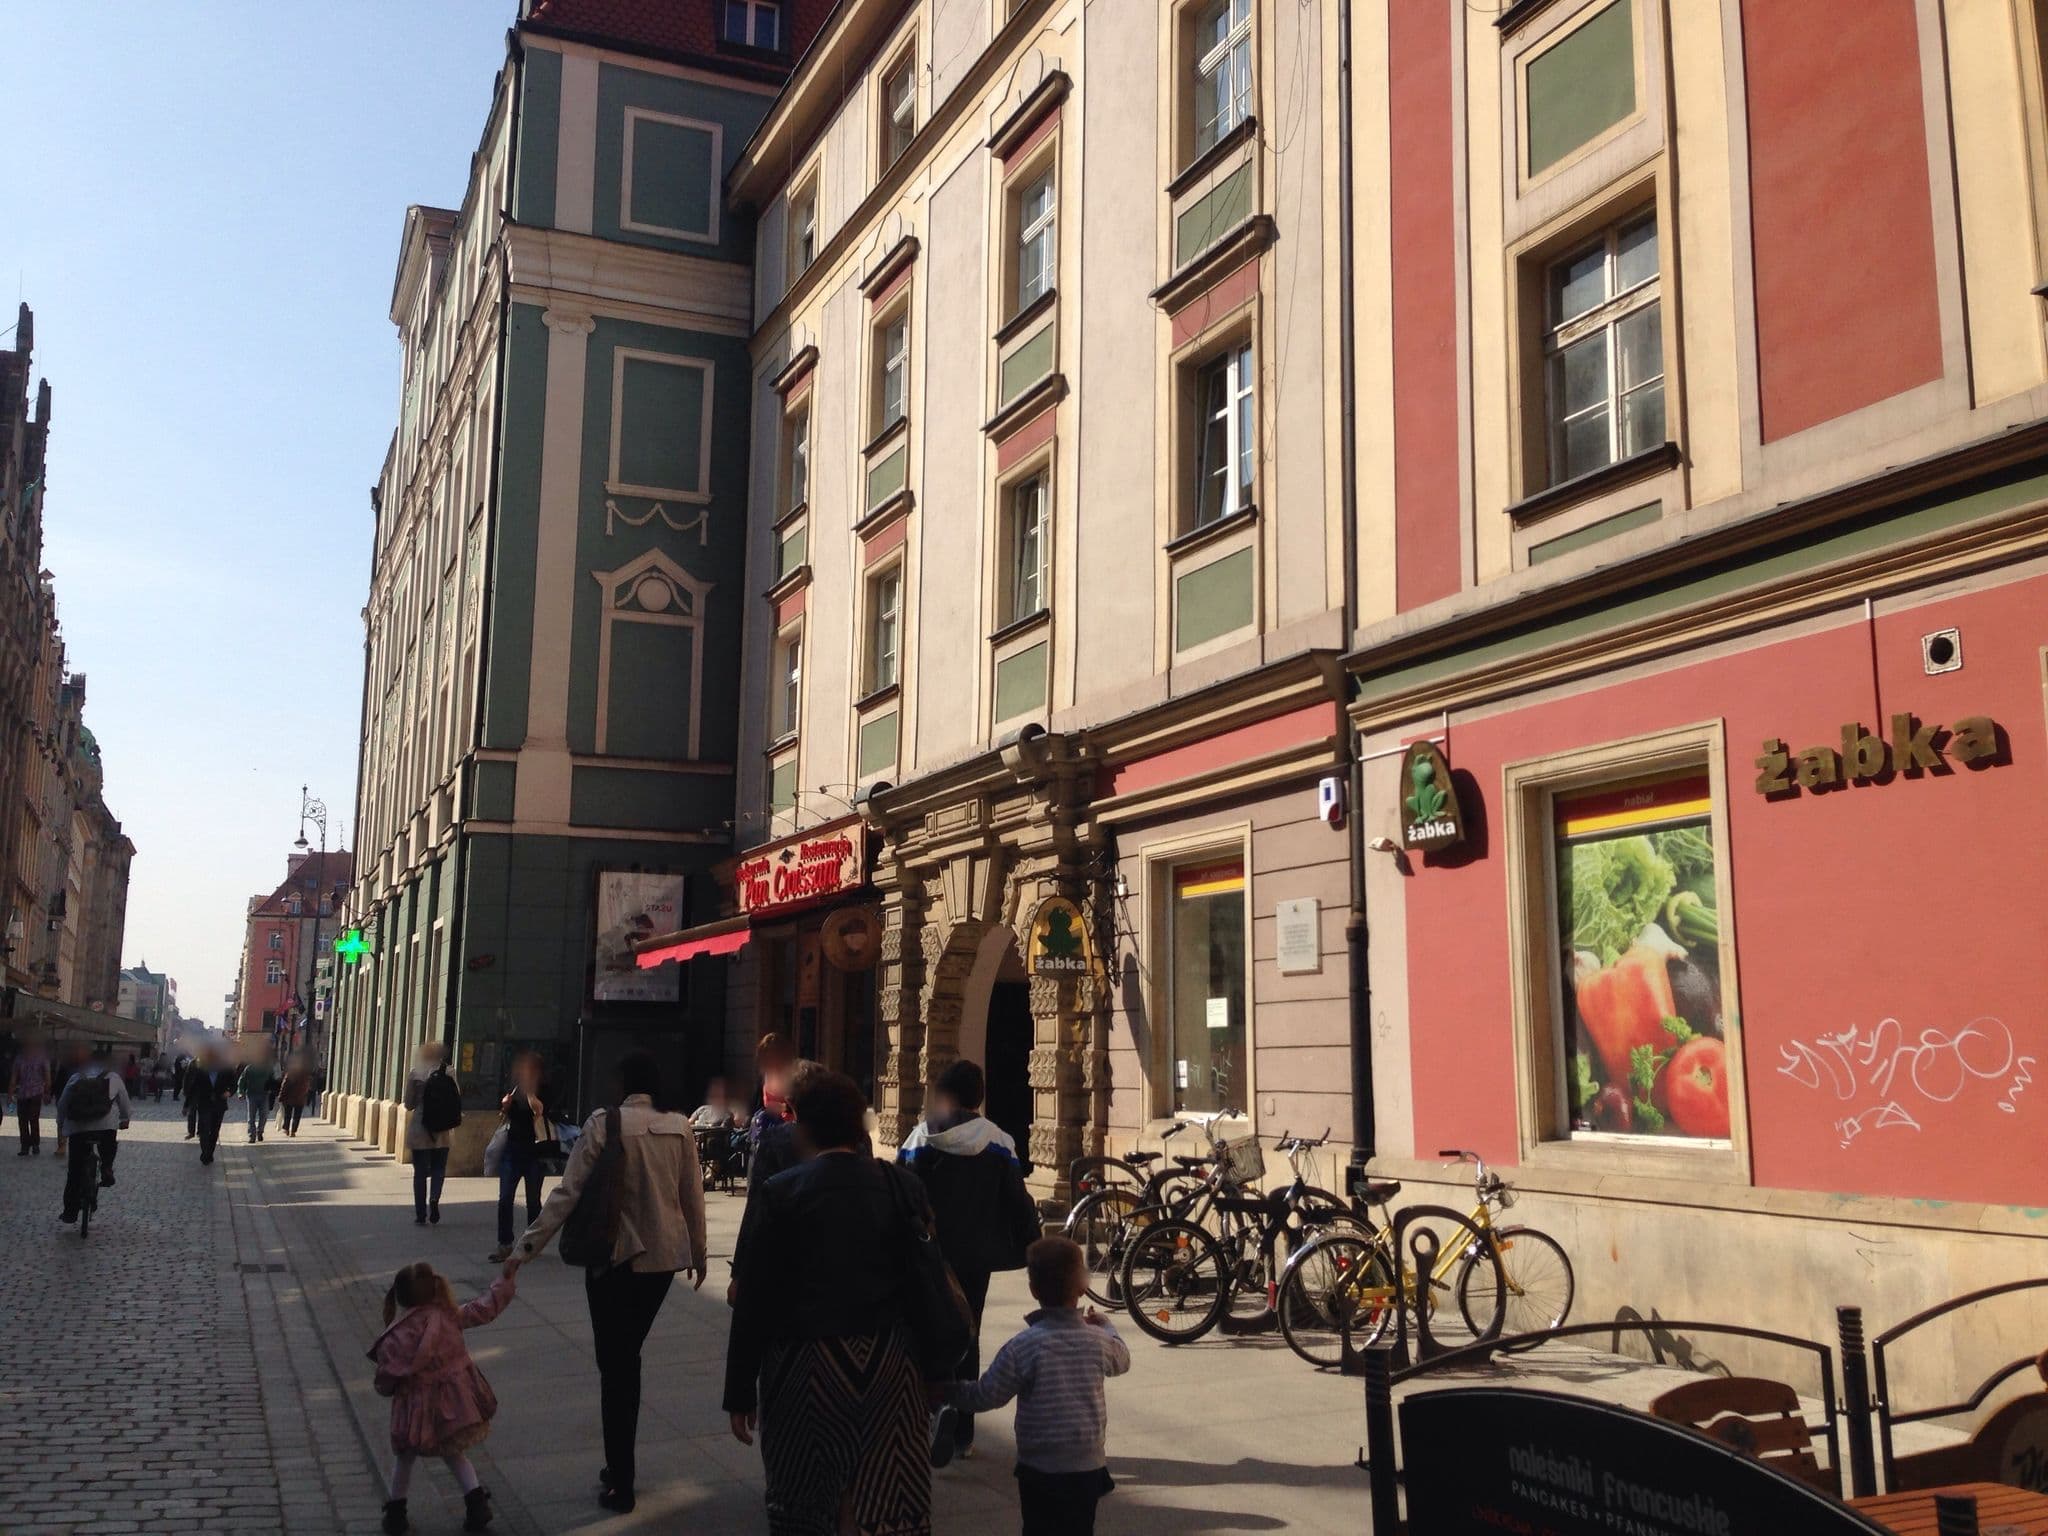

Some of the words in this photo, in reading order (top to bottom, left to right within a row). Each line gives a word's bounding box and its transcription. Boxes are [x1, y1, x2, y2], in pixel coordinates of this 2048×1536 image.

[1754, 711, 1998, 795] żabka
[1407, 820, 1456, 841] żabka
[1035, 956, 1086, 970] żabka
[1511, 1479, 1588, 1521] PANCAKES
